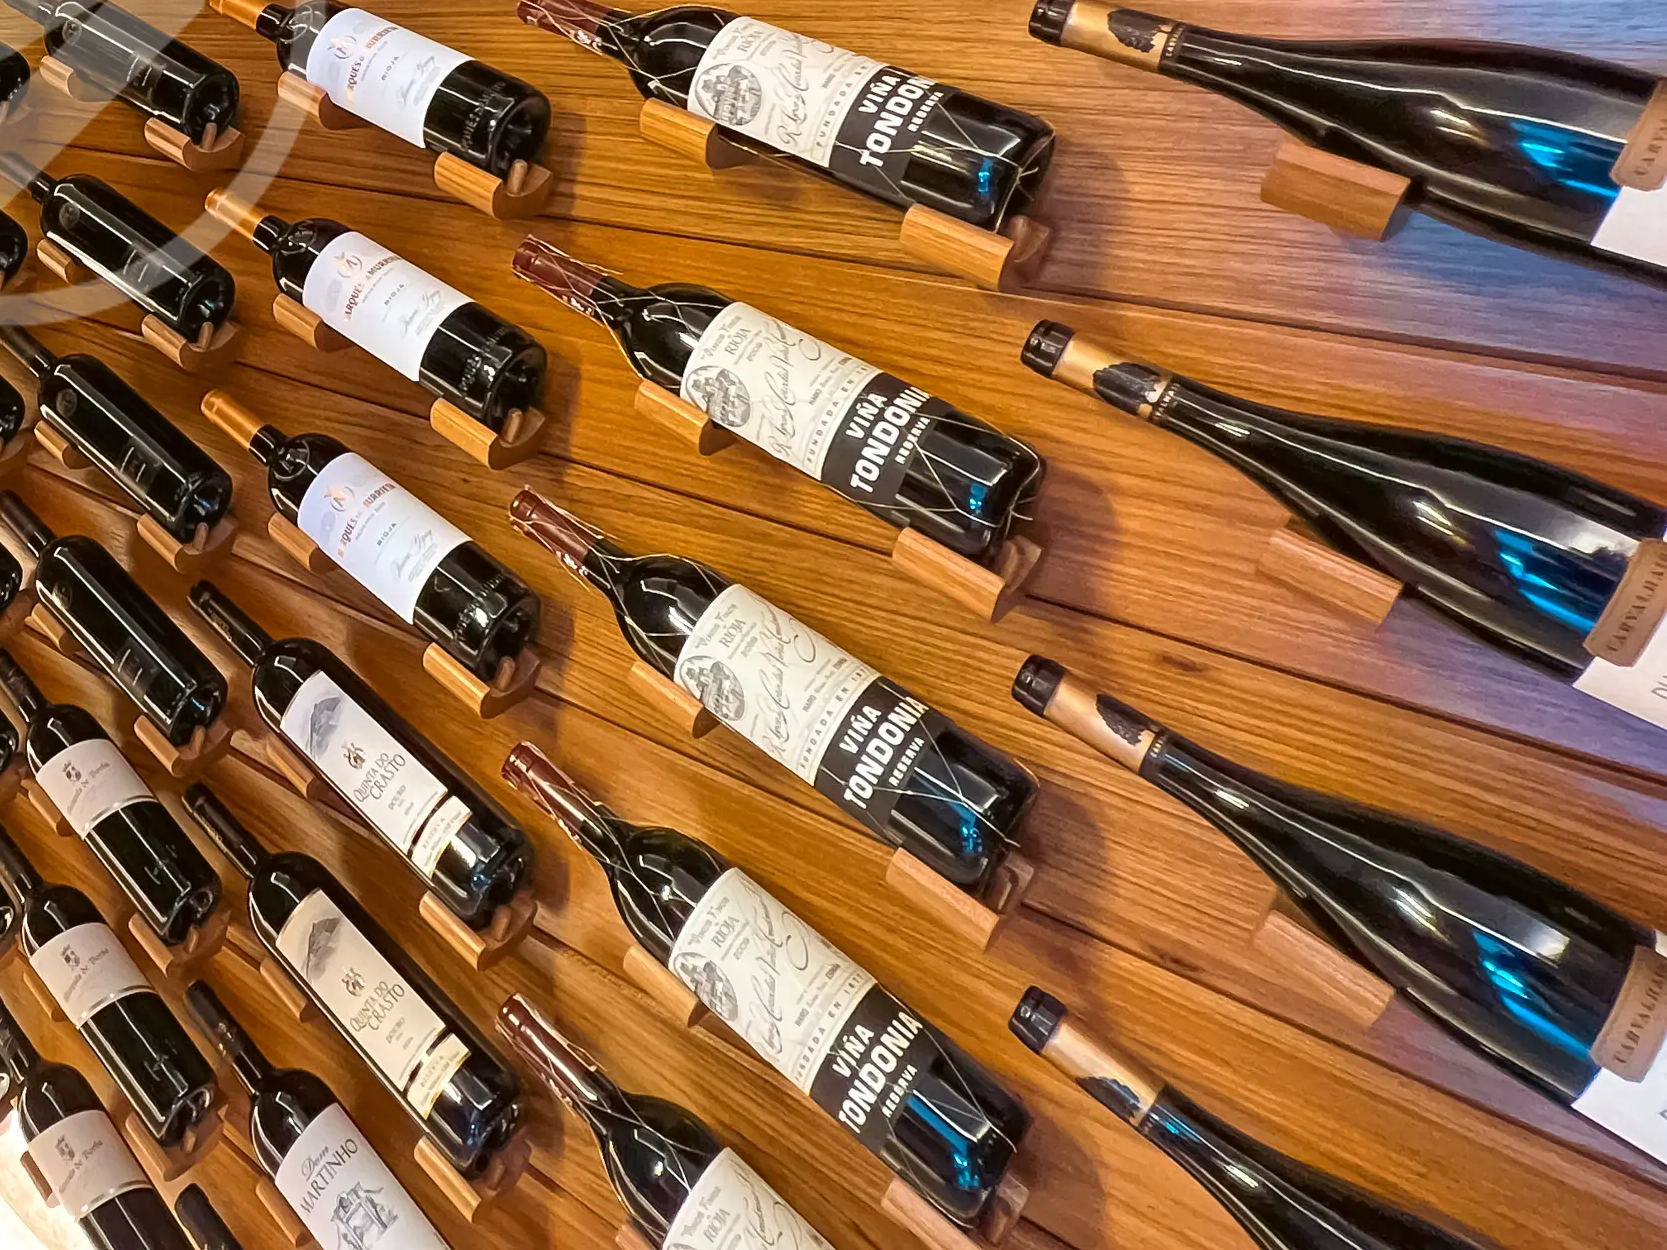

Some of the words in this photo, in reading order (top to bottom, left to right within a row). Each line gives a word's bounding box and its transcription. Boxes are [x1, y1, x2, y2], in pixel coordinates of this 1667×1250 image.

[858, 74, 902, 116] VIÑA
[859, 77, 934, 168] TONDON
[723, 327, 752, 357] RIOJA
[845, 390, 888, 440] VIÑA
[849, 385, 935, 495] TONDONIA
[718, 617, 747, 649] RIOJA
[838, 703, 883, 755] VIÑA
[842, 695, 931, 811] TONDONIA
[352, 767, 380, 803] QUINTA
[374, 751, 390, 770] DO
[369, 753, 406, 801] CRASTO
[888, 736, 926, 788] RESERVA
[710, 913, 741, 950] RIOJA
[349, 994, 379, 1033] QUINTA
[373, 980, 390, 999] DO
[367, 982, 406, 1031] CRASTO
[831, 1022, 875, 1080] VIÑA
[837, 1010, 924, 1136] TONDONIA
[881, 1064, 919, 1119] RESERVA
[299, 1137, 359, 1217] MARTINHO
